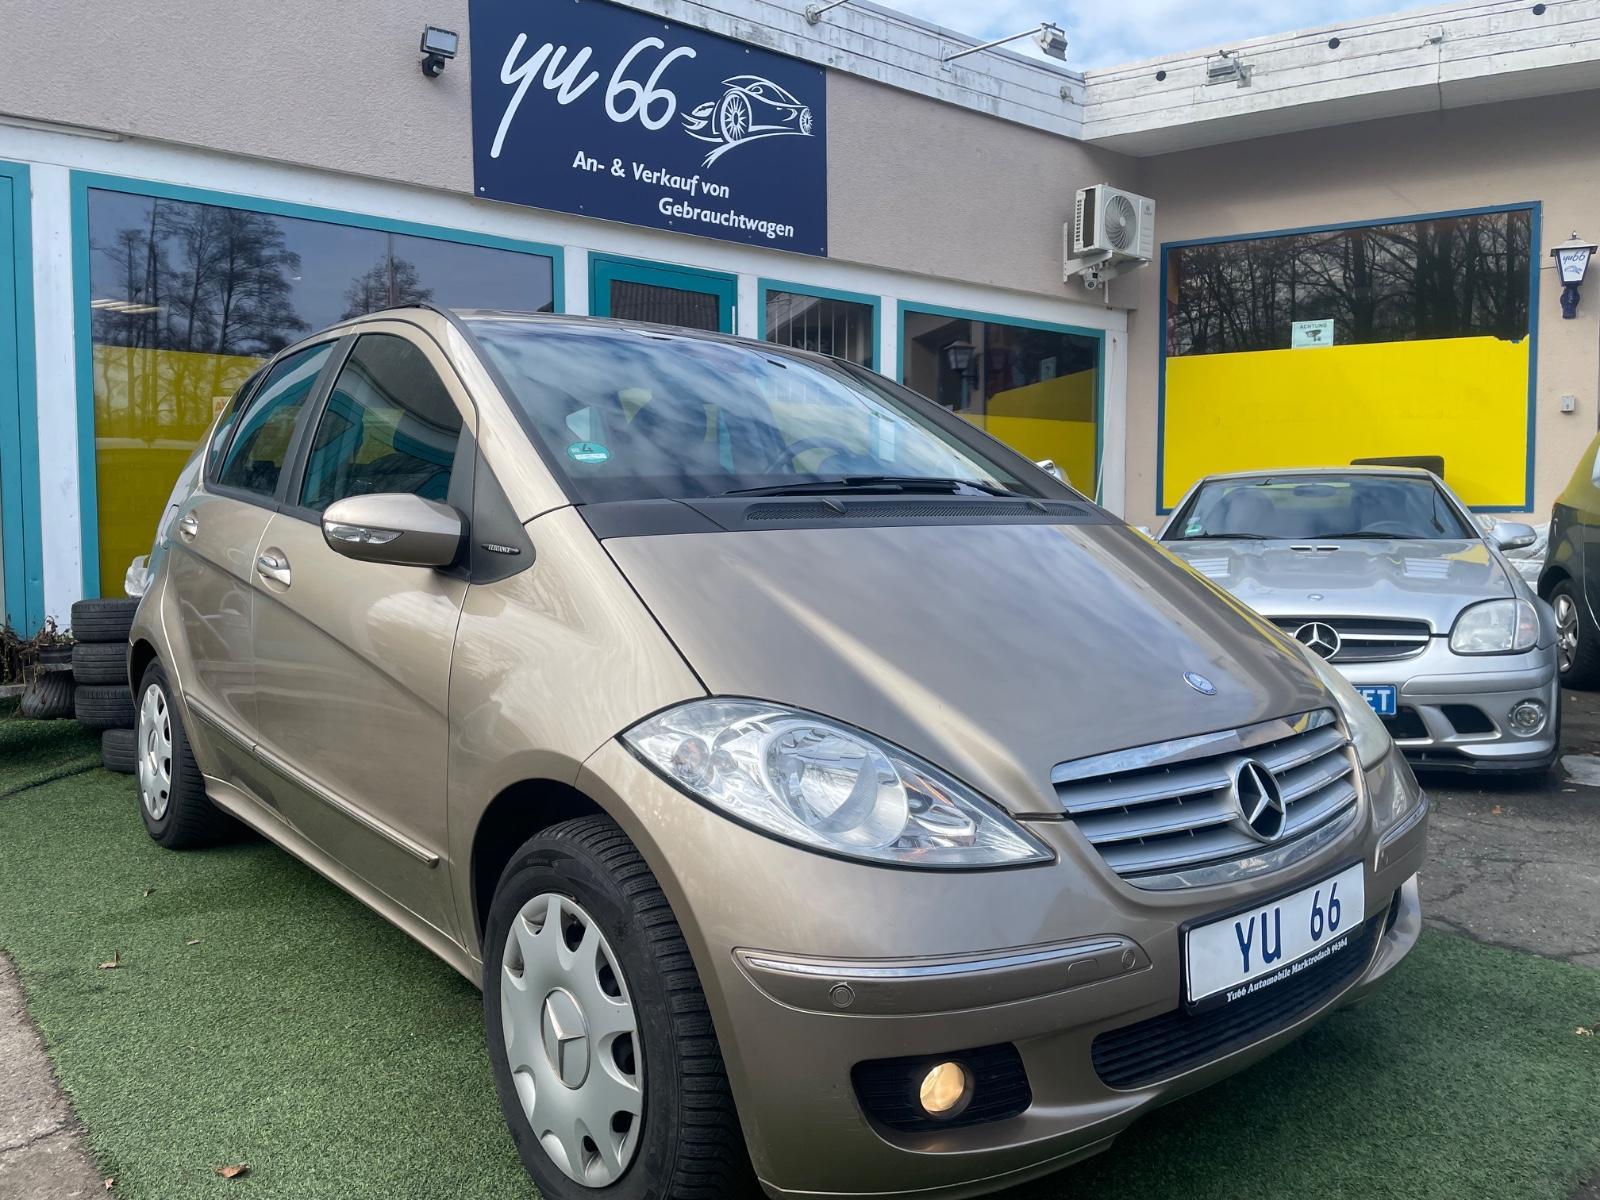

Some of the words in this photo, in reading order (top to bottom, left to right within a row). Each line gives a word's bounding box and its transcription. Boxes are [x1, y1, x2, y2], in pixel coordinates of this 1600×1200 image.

[573, 150, 605, 172] An-
[610, 158, 626, 178] &
[632, 162, 700, 197] Verkauf
[701, 182, 730, 199] von
[658, 197, 794, 239] Gebrauchtwagen
[1234, 907, 1282, 974] YU
[1310, 882, 1341, 942] 66
[1226, 986, 1247, 1003] Yu66
[1247, 968, 1290, 994] Automobile
[1290, 947, 1331, 975] Marktrodach
